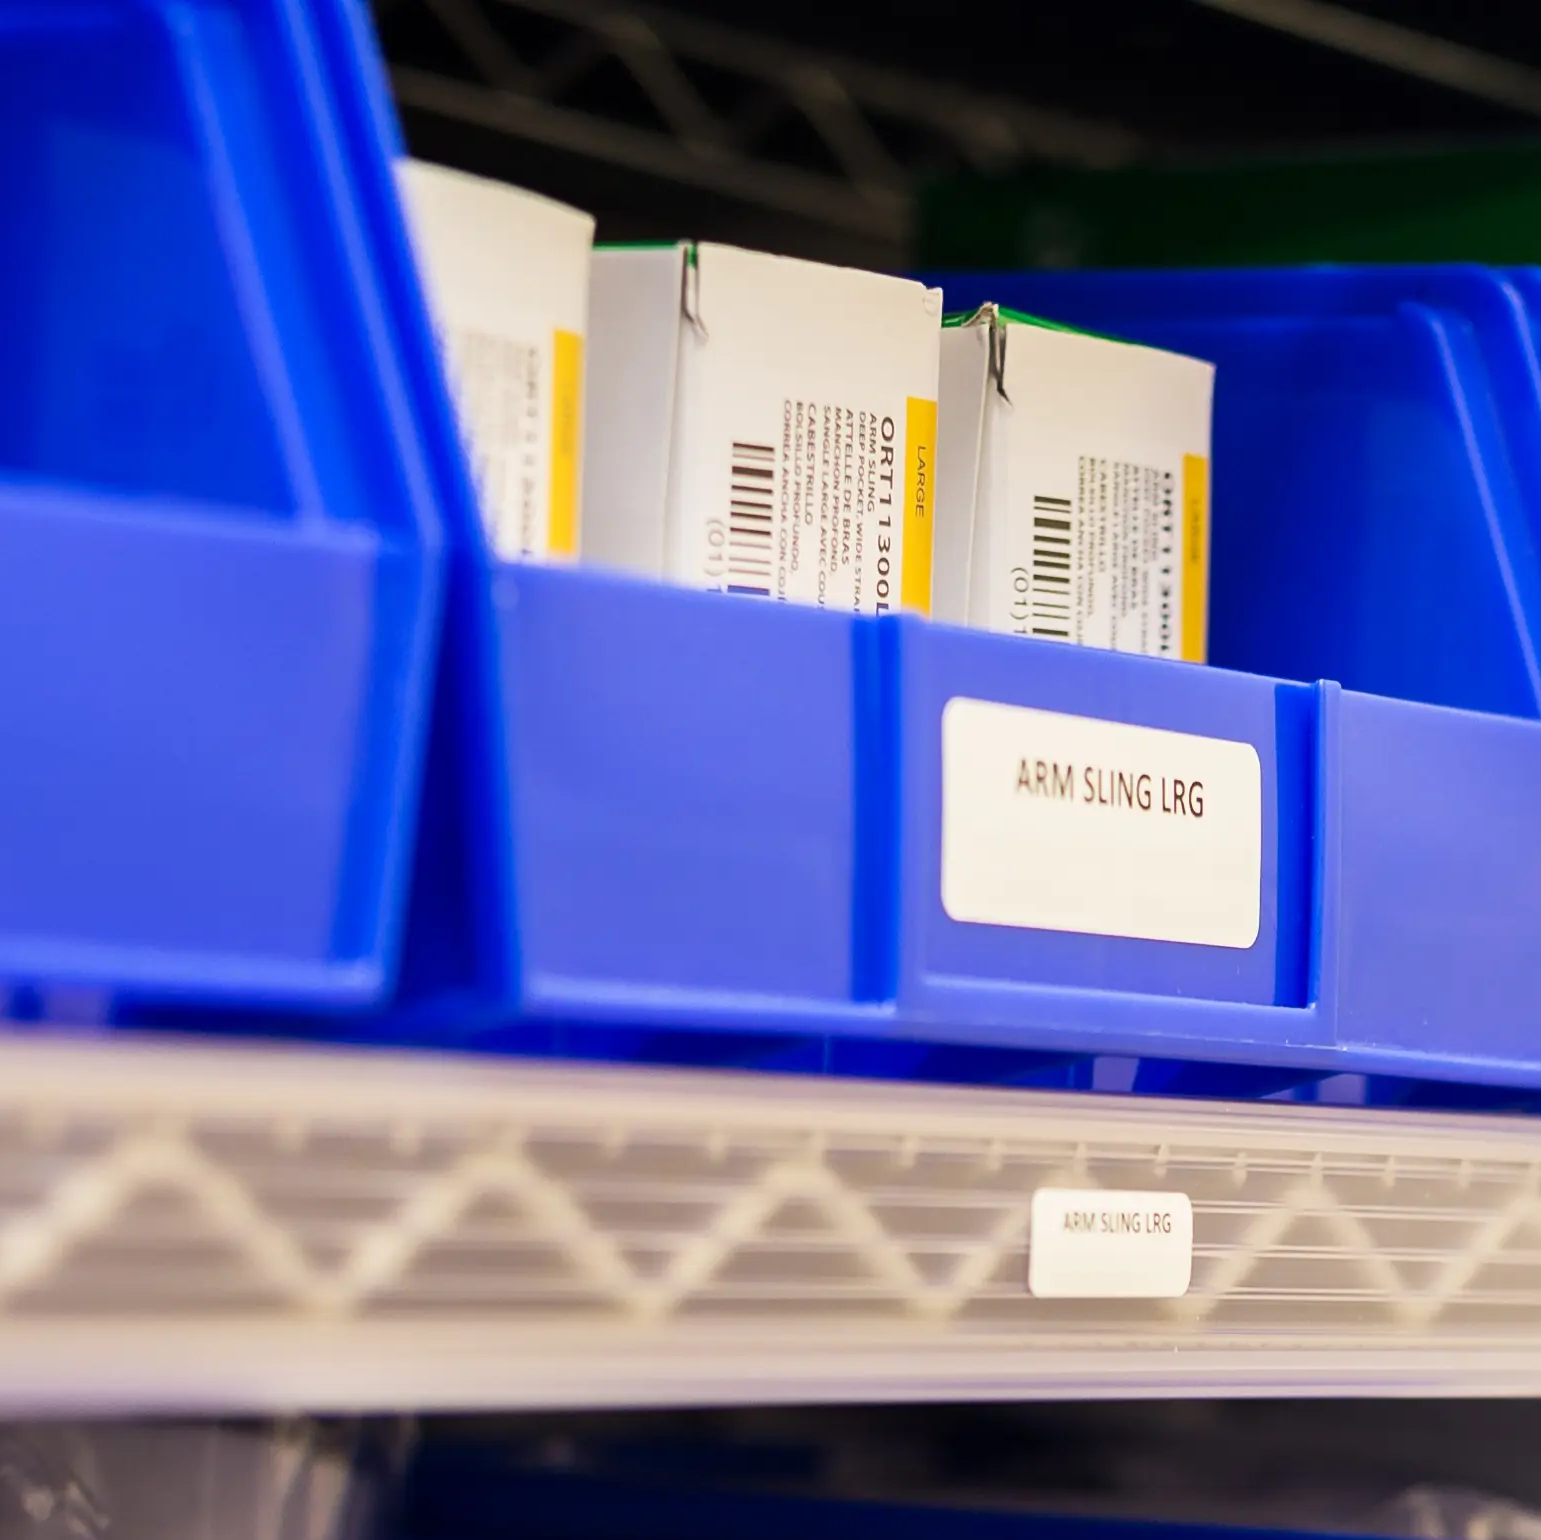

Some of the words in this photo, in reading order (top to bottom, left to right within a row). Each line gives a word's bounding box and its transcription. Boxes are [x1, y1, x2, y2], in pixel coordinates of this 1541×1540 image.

[782, 399, 792, 462] CORREA
[794, 401, 804, 477] BOLSILLO
[823, 405, 831, 467] SANGLE
[833, 407, 842, 491] MANCHON
[844, 409, 853, 484] ATTELLE
[868, 413, 877, 454] ARM
[805, 402, 817, 525] CABESTRILLO
[867, 460, 876, 512] SLING
[915, 446, 927, 519] LARGE
[780, 467, 789, 524] ANCHA
[821, 471, 829, 520] LARGE
[843, 489, 852, 513] DE
[779, 528, 787, 562] CON
[819, 526, 827, 567] AVEC
[842, 518, 850, 565] BRAS
[855, 522, 863, 562] WIDE
[1016, 758, 1075, 802] ARM
[1083, 765, 1153, 811] SLING
[1161, 775, 1205, 818] LRG
[1063, 1212, 1096, 1235] ARM
[1100, 1212, 1141, 1234] SLING
[1145, 1212, 1172, 1234] LRG
